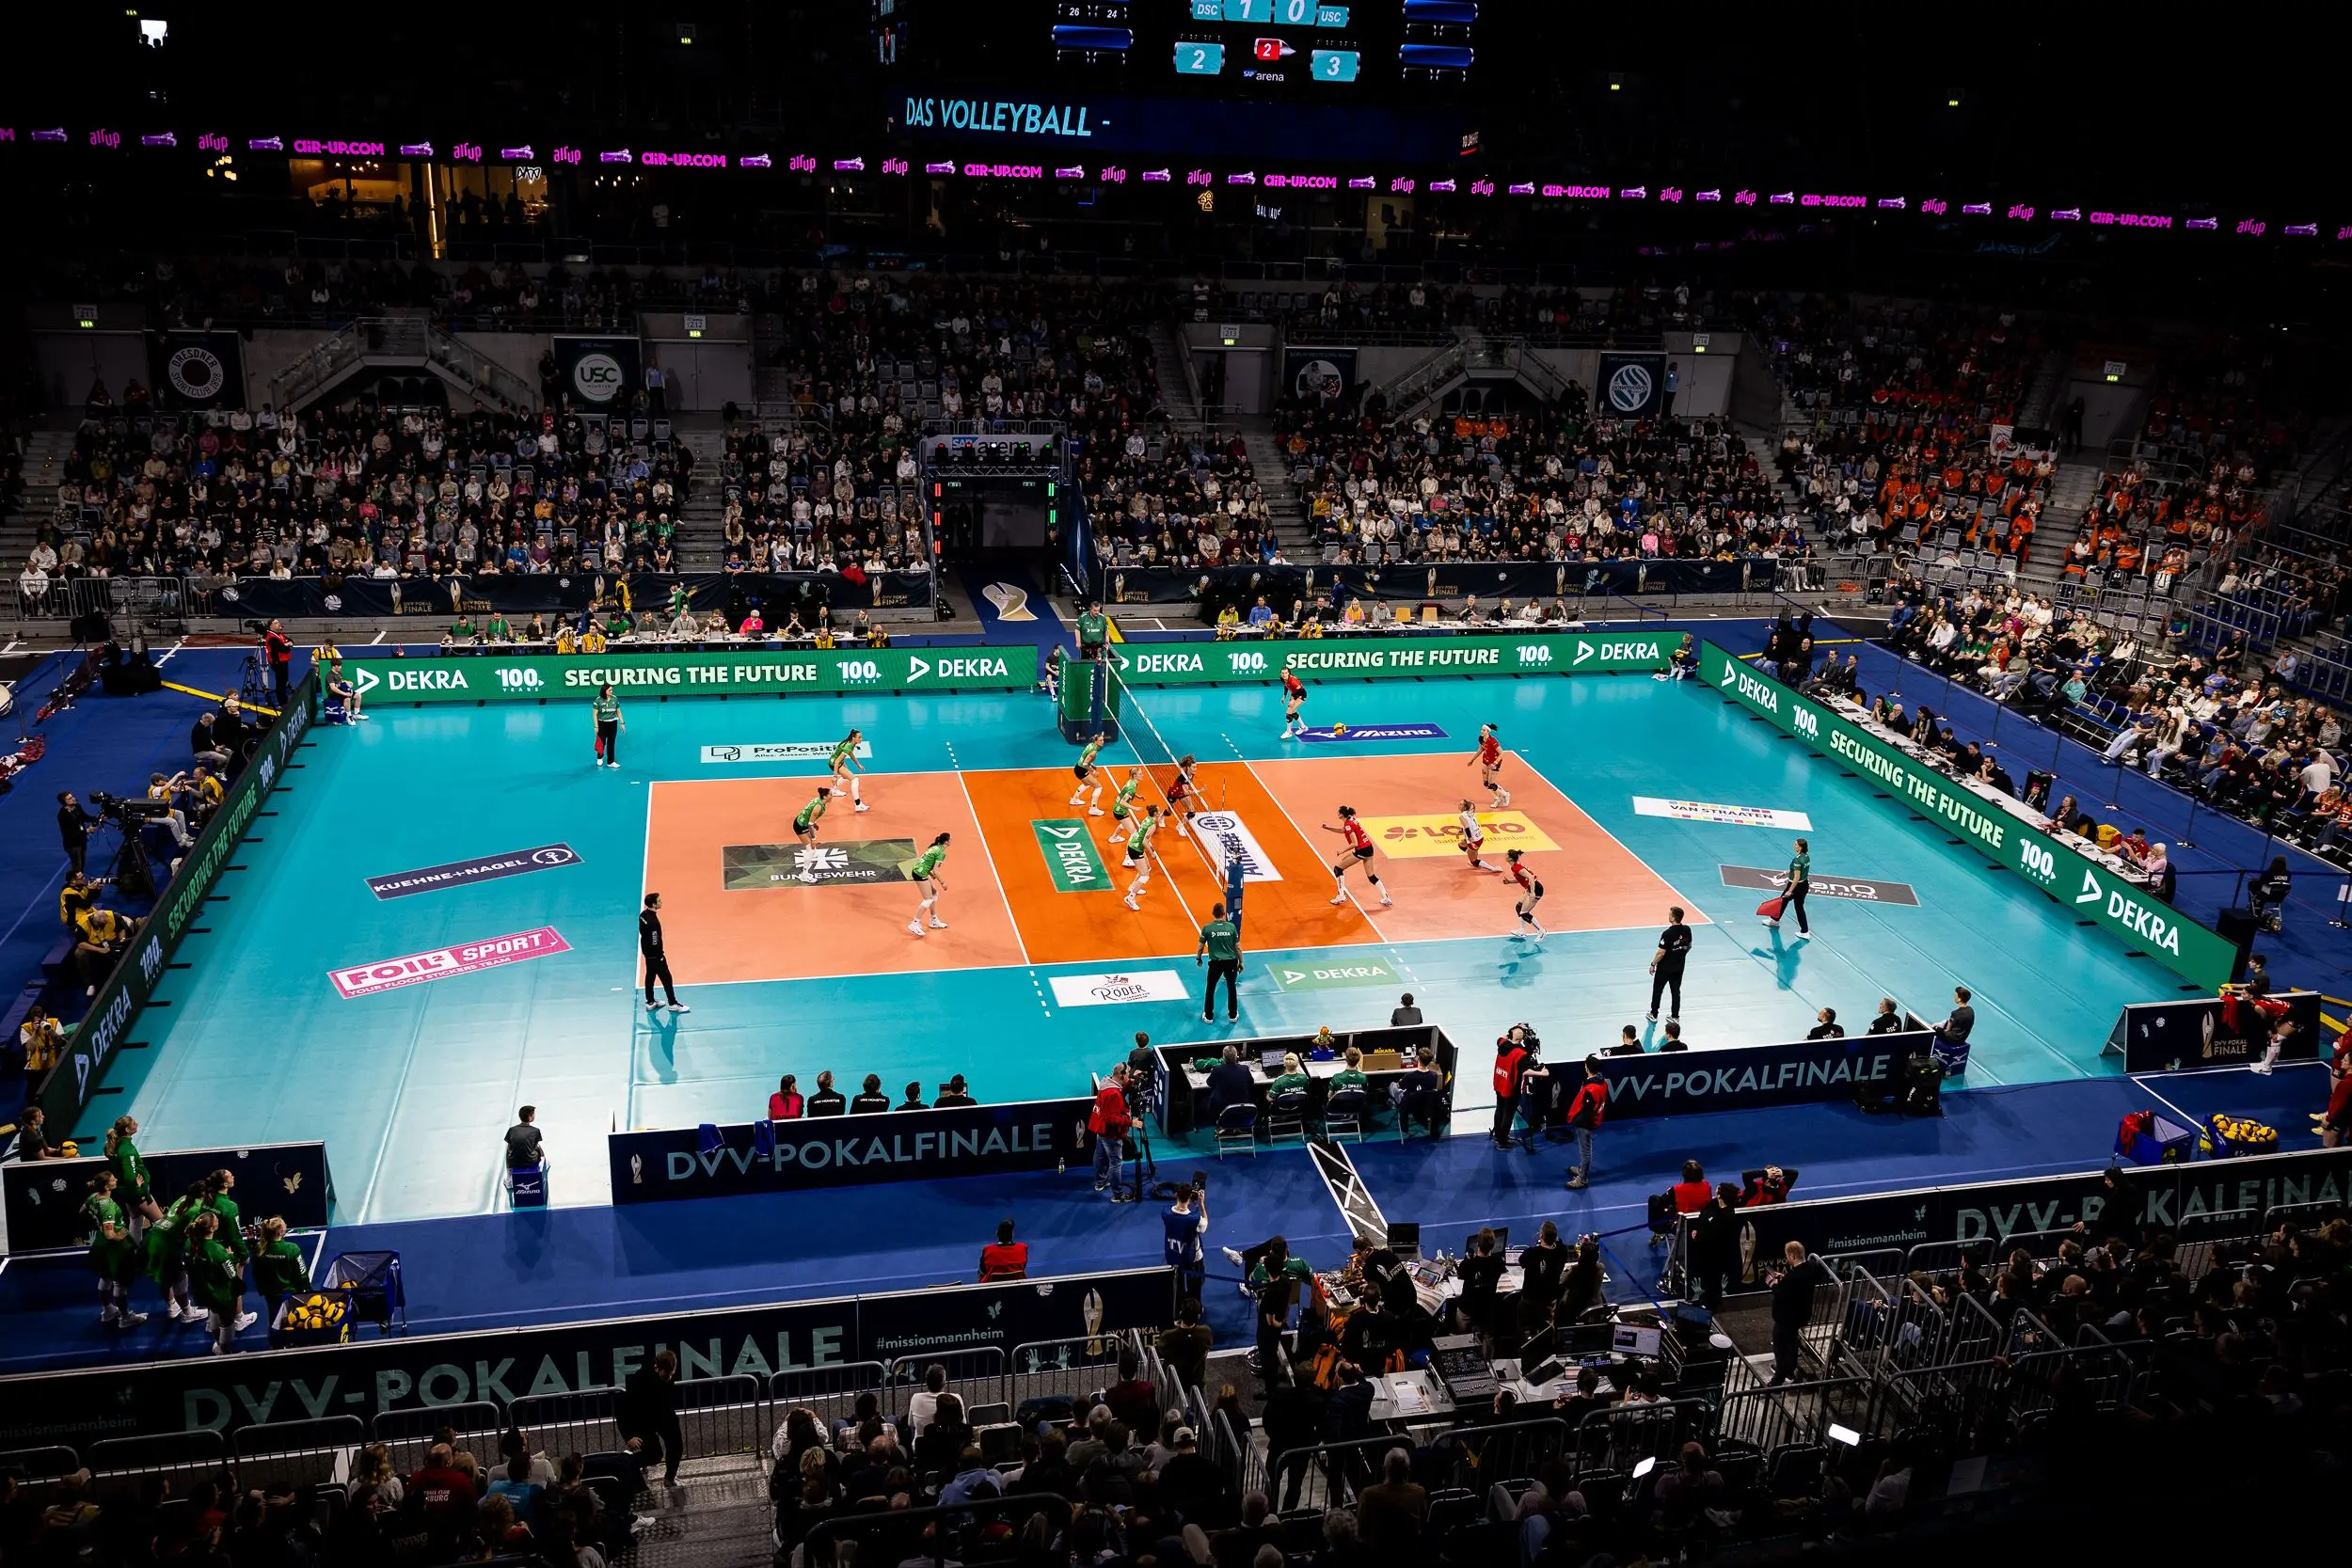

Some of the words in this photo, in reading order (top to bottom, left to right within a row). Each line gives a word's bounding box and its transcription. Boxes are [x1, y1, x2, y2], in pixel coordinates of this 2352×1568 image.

[1069, 7, 1080, 16] 26
[1106, 9, 1118, 19] 24
[1197, 3, 1218, 16] DSC
[1239, 0, 1252, 19] 1
[1288, 0, 1305, 22] 0
[1321, 10, 1342, 23] USC
[1191, 49, 1206, 70] 2
[1263, 43, 1272, 56] 2
[1327, 56, 1342, 75] 3
[1256, 71, 1284, 82] arena
[906, 97, 934, 127] DAS
[940, 99, 1092, 136] VOLLEYBALL
[172, 348, 218, 368] DRESDNER
[171, 372, 211, 397] SPORTCLUB
[580, 367, 617, 384] USC
[978, 440, 1031, 455] arena
[1285, 651, 1384, 670] SECURING
[1389, 649, 1425, 667] THE
[1428, 647, 1500, 665] FUTURE
[1599, 641, 1660, 661] DEKRA
[938, 657, 1009, 678] DEKRA
[1136, 654, 1204, 673] DEKRA
[388, 669, 469, 690] DEKRA
[564, 665, 681, 688] SECURING
[686, 665, 732, 685] THE
[734, 662, 818, 683] FUTURE
[1738, 672, 1778, 714] DEKRA
[287, 700, 308, 746] DEKRA
[754, 743, 862, 754] ProPositin
[1829, 729, 1903, 788] SECURING
[1906, 772, 1938, 807] THE
[1939, 793, 2005, 849] FUTURE
[1702, 808, 1773, 820] STRAATEN
[1422, 822, 1526, 837] LOTO
[167, 852, 214, 941] SECURING
[213, 826, 229, 866] THE
[228, 782, 257, 843] FUTURE
[1055, 841, 1096, 885] DEKRA
[373, 858, 529, 893] KUEHNE+NAGEL
[2106, 890, 2180, 957] DEKRA
[461, 932, 544, 962] SPORT
[347, 984, 382, 997] YOUR
[384, 974, 425, 990] FLOOR
[425, 964, 478, 980] STICKERS
[478, 956, 513, 970] TEAM
[1312, 965, 1387, 981] DEKRA
[1091, 984, 1146, 1001] RÖDER
[90, 984, 133, 1068] DEKRA
[2214, 1044, 2248, 1055] FINALE
[1605, 1054, 1891, 1102] VV-POKALFINALE
[667, 1122, 1054, 1180] DVV-POKALFINALE
[1167, 1237, 1187, 1255] TV
[1826, 1228, 1928, 1250] #missionmannheim
[876, 1326, 1005, 1350] #missionmannheim
[1104, 1334, 1161, 1350] FINLE
[183, 1325, 845, 1433] DVV-POKALFNALE
